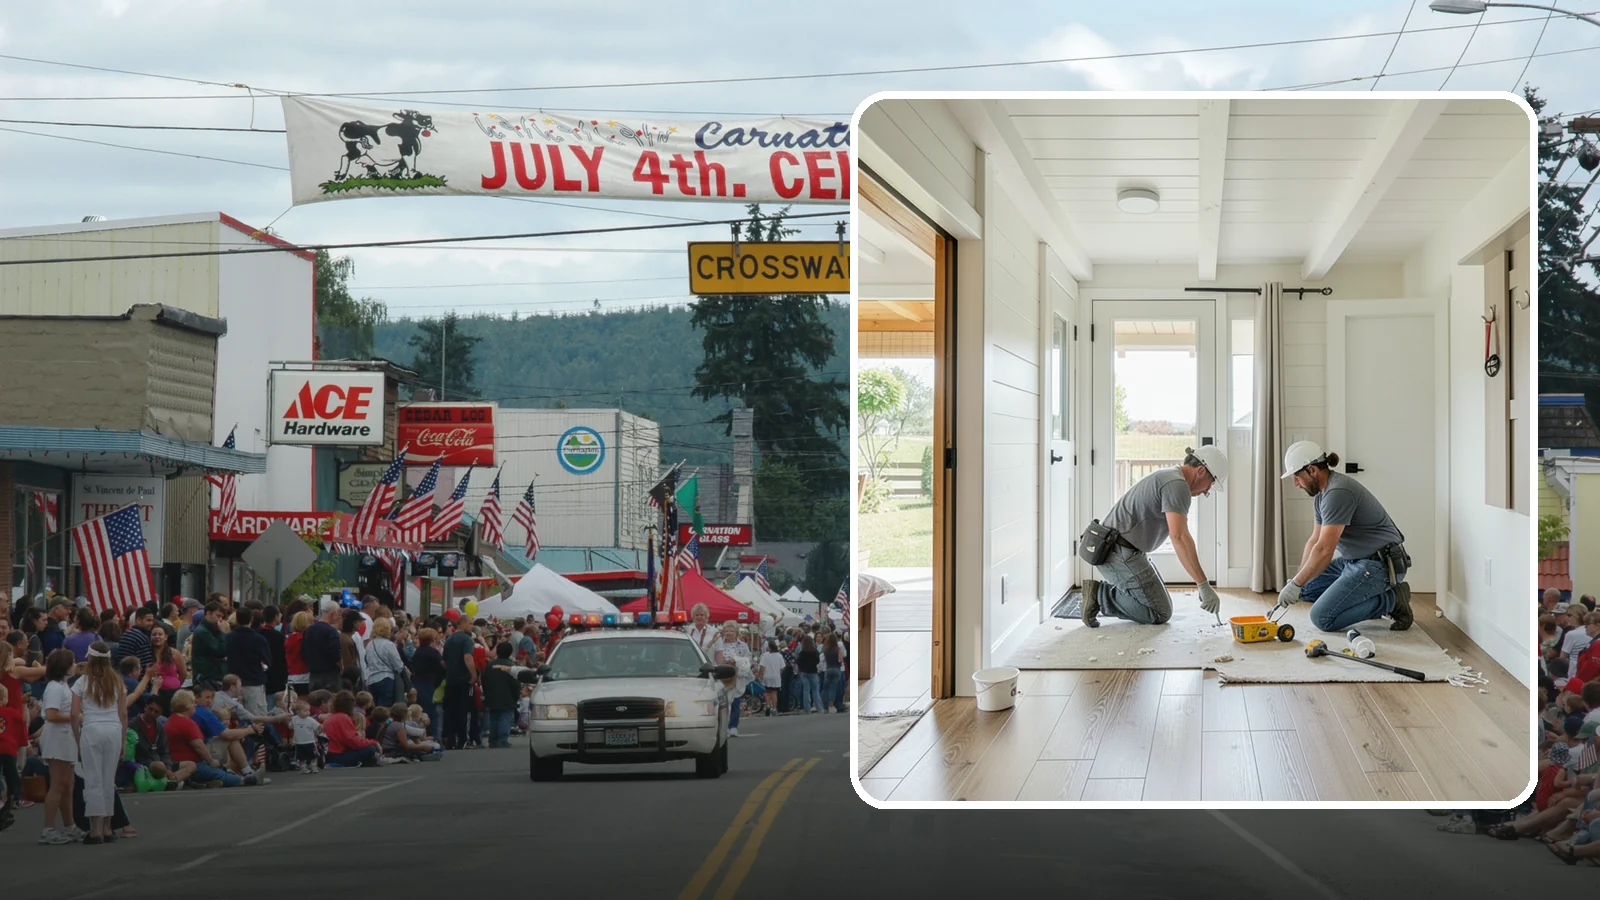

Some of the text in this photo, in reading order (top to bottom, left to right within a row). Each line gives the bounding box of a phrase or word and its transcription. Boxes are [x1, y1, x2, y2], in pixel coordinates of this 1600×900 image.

[695, 121, 850, 150] Carnat
[481, 141, 605, 192] JULY
[632, 150, 746, 198] 4th.
[697, 254, 850, 280] CROSSWA
[282, 380, 374, 420] ACE
[405, 409, 486, 422] CEDAR LOG
[283, 421, 371, 437] Hardware
[353, 467, 386, 481] Simpl
[96, 484, 124, 495] Vincent
[126, 485, 136, 495] de
[138, 486, 155, 496] Paul
[212, 516, 330, 535] HARDARE
[688, 526, 742, 536] CRNATION
[699, 535, 730, 544] GLASS
